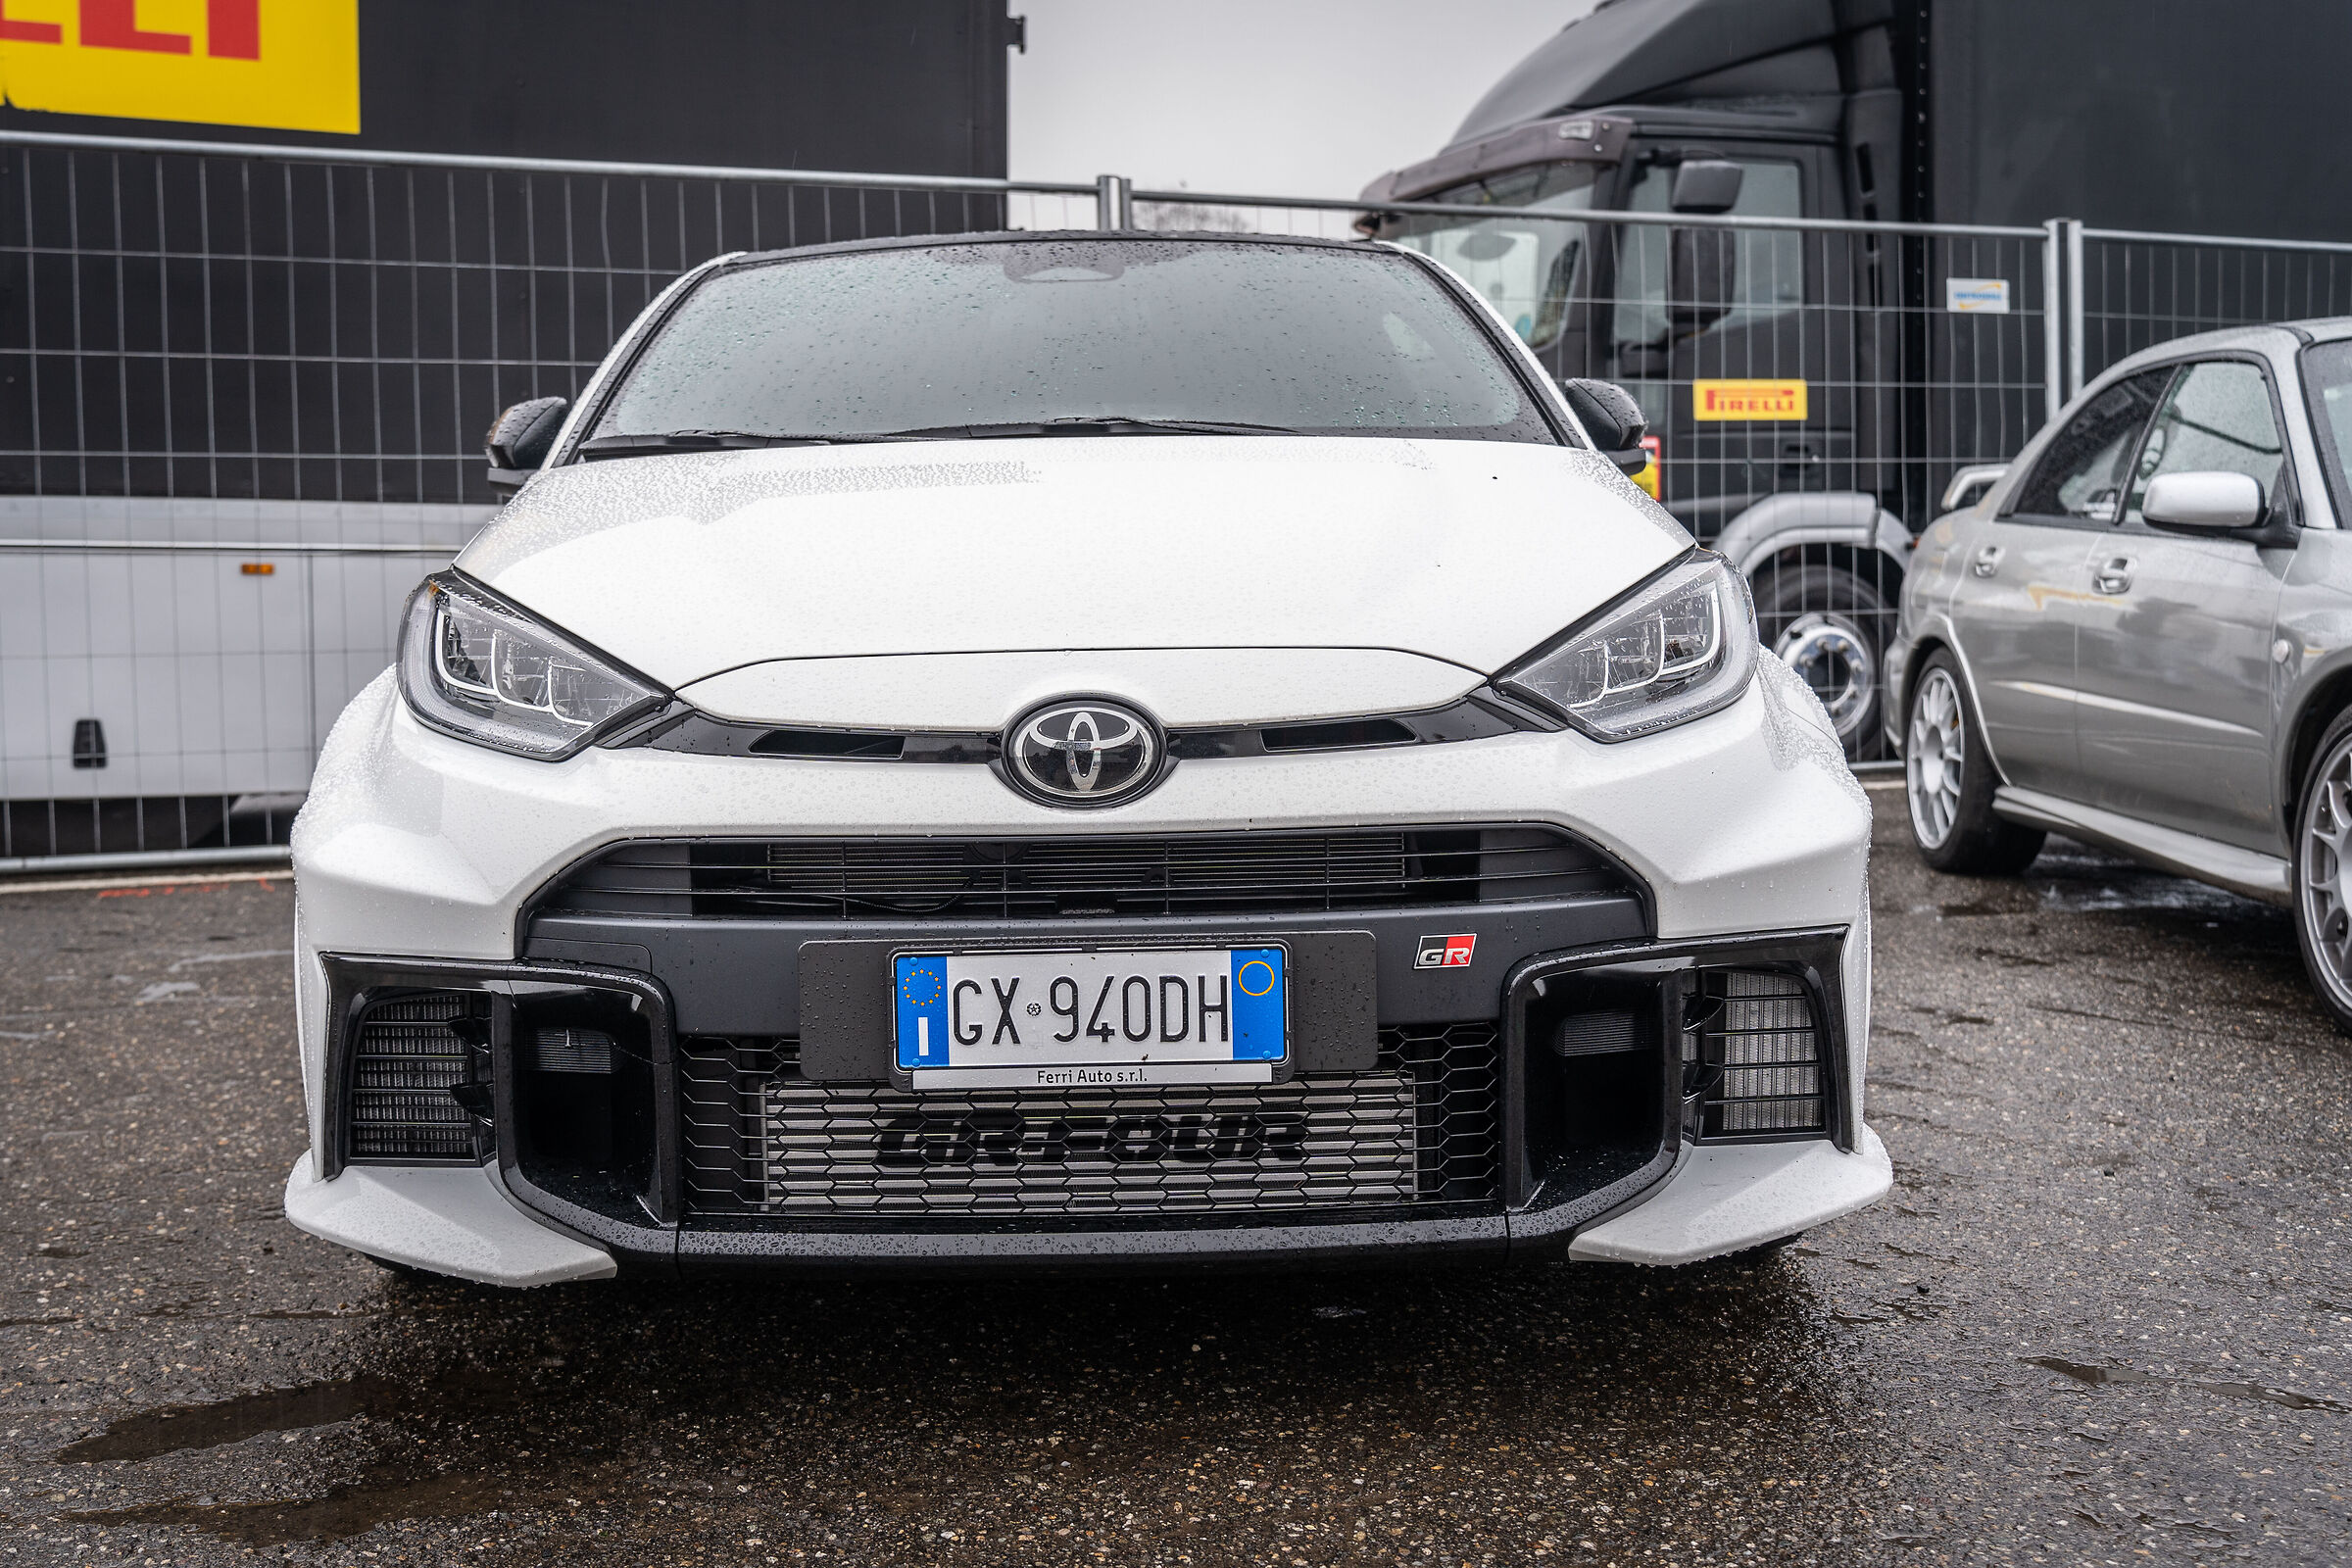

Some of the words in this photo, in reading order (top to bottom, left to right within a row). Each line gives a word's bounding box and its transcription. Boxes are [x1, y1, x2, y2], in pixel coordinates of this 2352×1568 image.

[1705, 388, 1794, 412] PIRELLI
[1418, 947, 1470, 965] GR
[952, 976, 1021, 1047] GX
[1049, 974, 1230, 1044] 940DH
[1037, 1069, 1072, 1084] Ferri
[1077, 1069, 1112, 1083] Auto
[1117, 1068, 1148, 1082] s.r.l.
